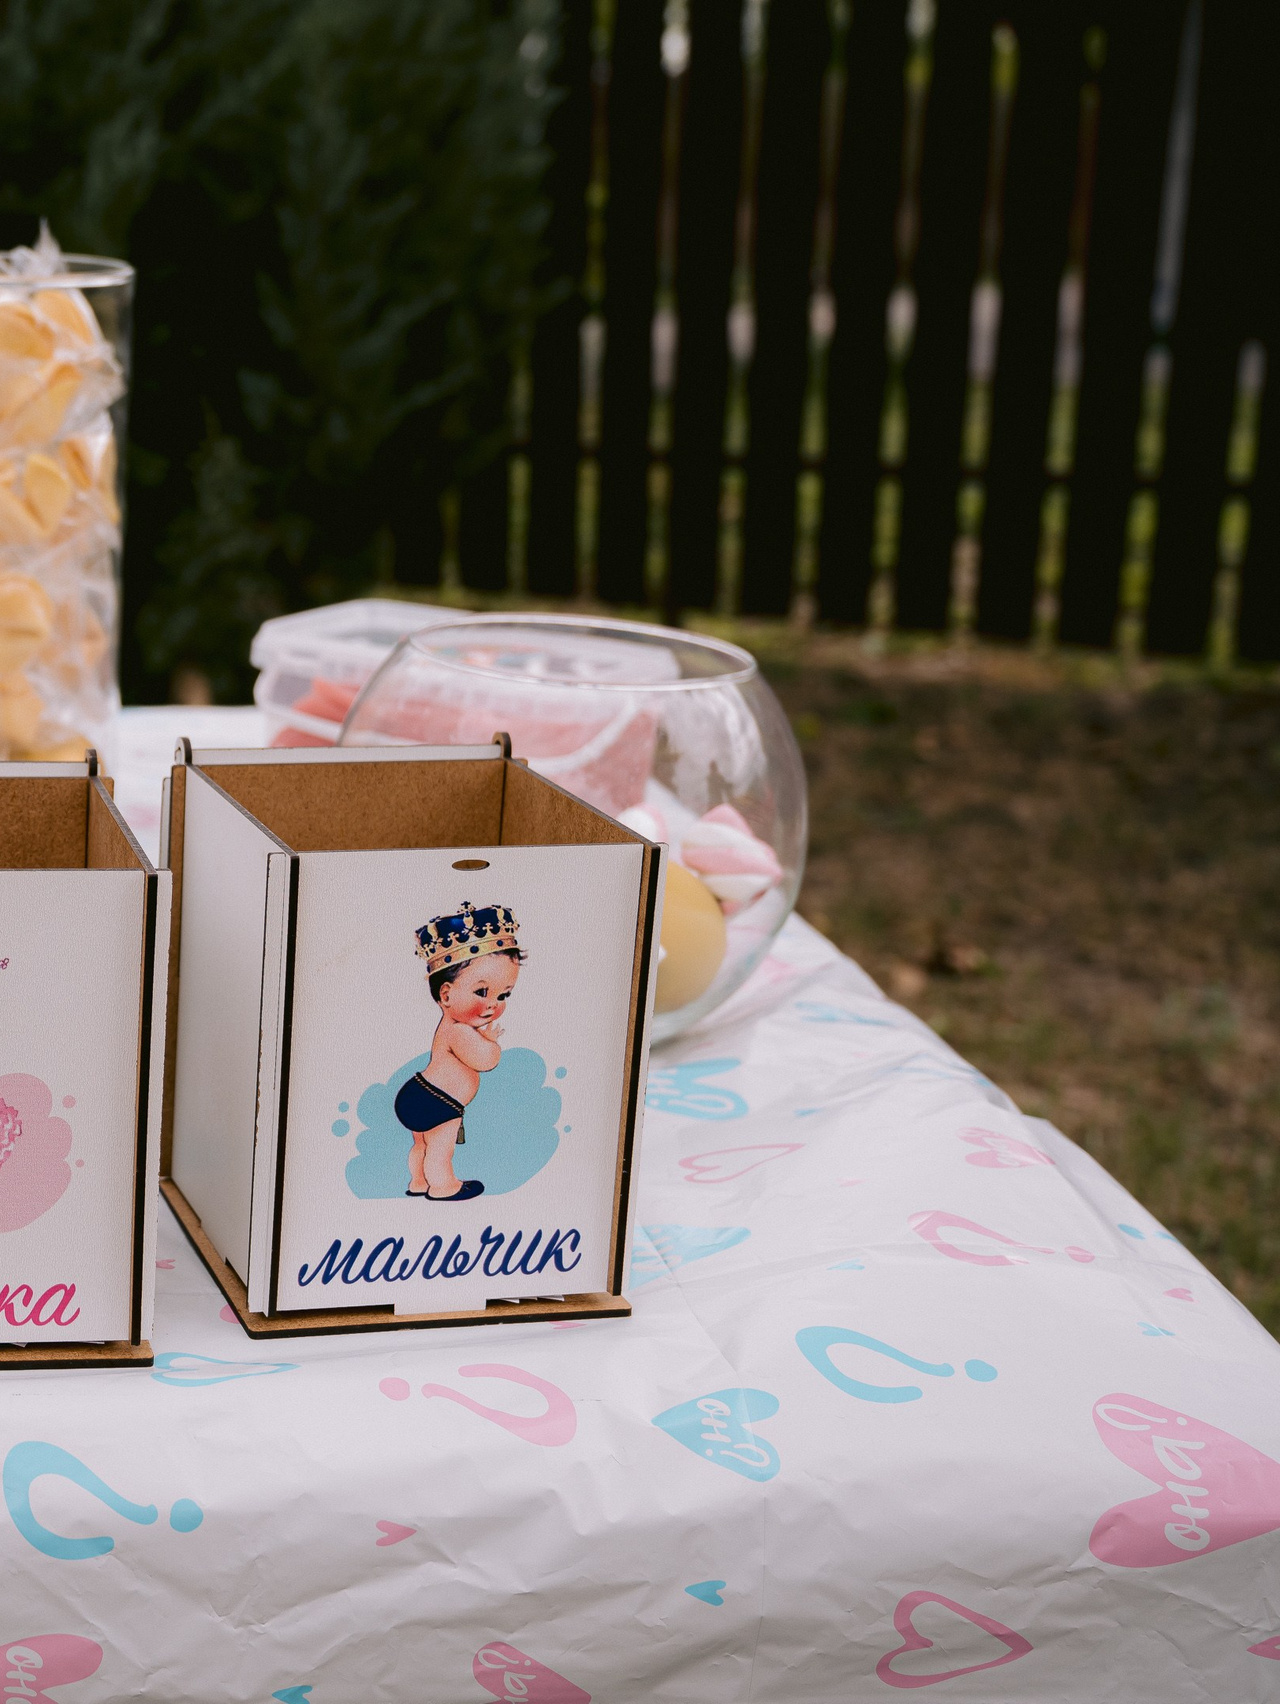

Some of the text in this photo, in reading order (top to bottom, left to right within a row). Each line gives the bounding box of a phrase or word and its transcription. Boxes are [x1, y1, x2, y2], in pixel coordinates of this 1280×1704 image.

[298, 1225, 582, 1287] мальчик
[697, 1398, 770, 1467] он?
[1095, 1403, 1211, 1551] она?
